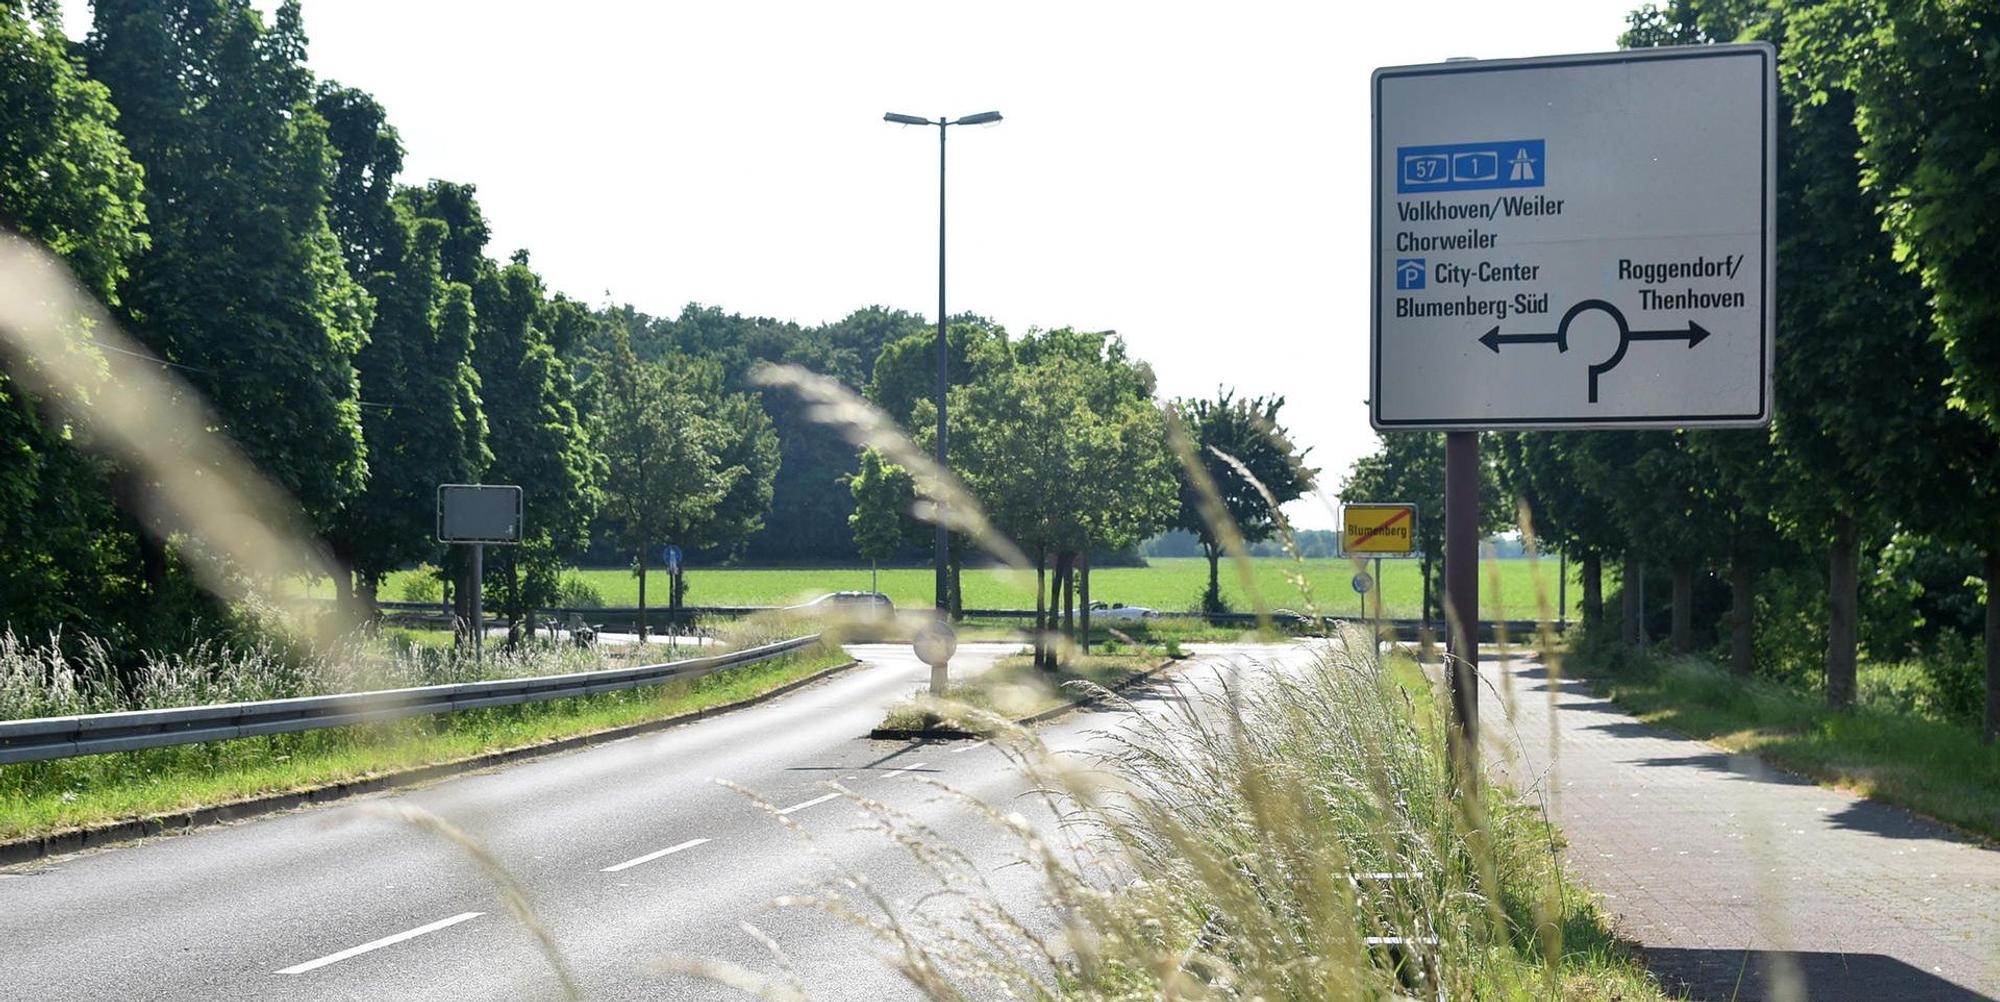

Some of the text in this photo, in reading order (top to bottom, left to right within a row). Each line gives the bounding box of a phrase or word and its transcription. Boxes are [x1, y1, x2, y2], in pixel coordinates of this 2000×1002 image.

[1416, 159, 1479, 178] 57 1
[1397, 197, 1565, 222] Volkhoven/Weiler
[1396, 229, 1498, 252] Chorweiler
[1435, 261, 1540, 287] City-Center
[1618, 254, 1744, 284] Roggendorf/
[1396, 293, 1549, 320] Blumenberg-Süd
[1639, 288, 1745, 311] Thenhoven
